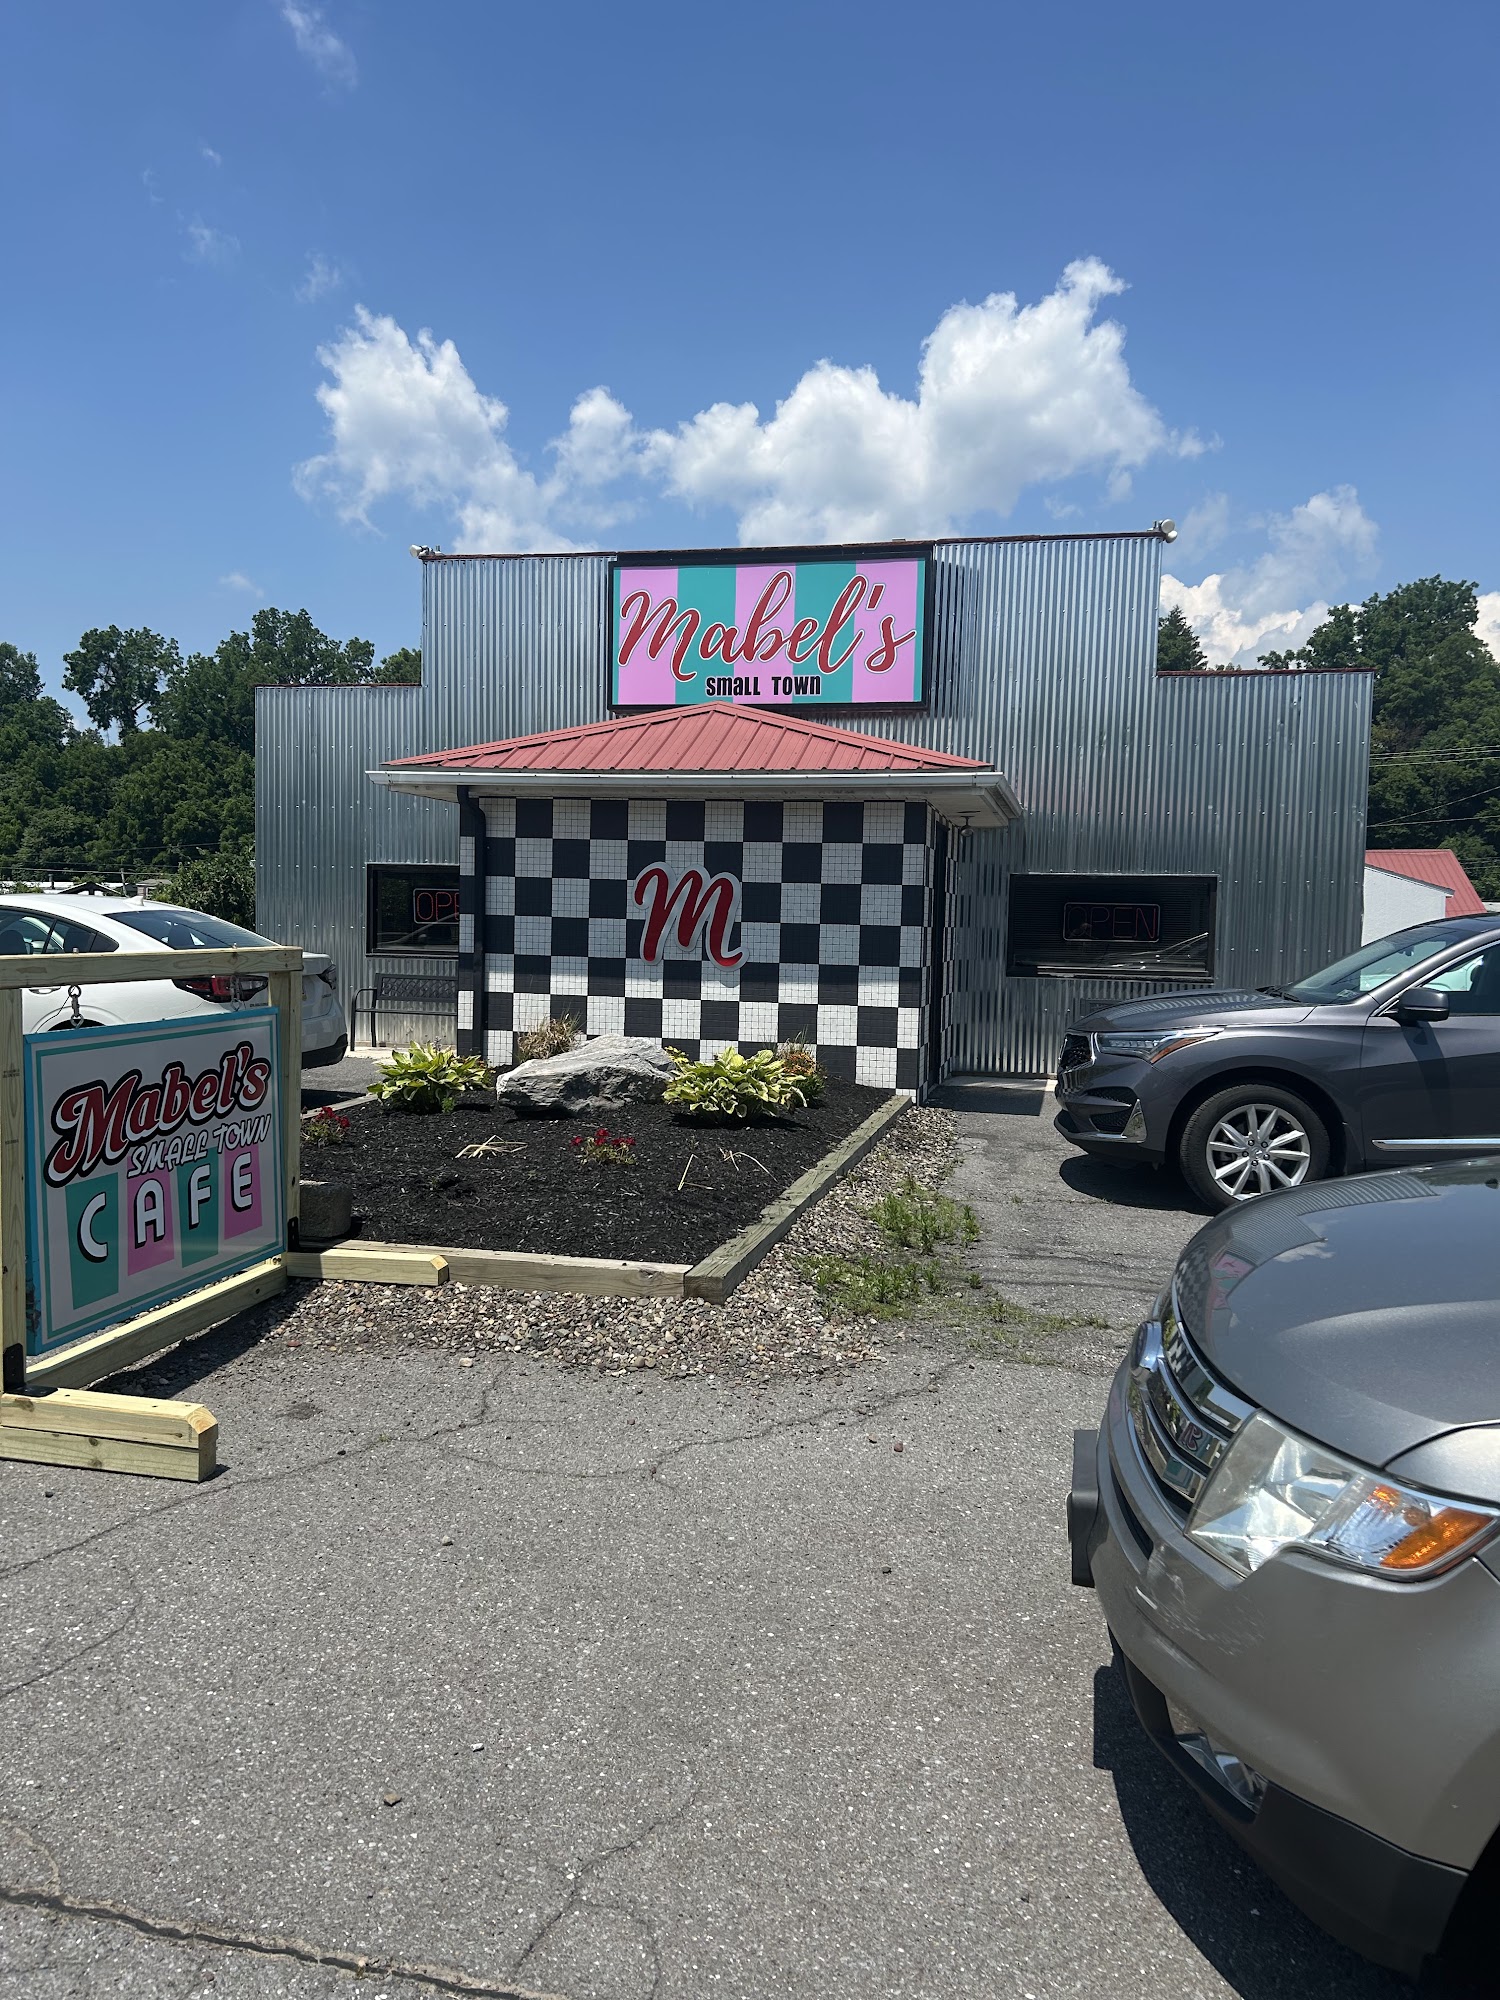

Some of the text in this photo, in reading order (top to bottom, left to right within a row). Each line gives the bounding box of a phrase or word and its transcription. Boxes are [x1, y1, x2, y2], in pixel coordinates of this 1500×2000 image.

[617, 571, 917, 682] Mabel's
[1068, 906, 1157, 939] OPEN
[46, 1043, 270, 1185] Mabel's
[128, 1114, 271, 1178] SMALL TOWN
[77, 1152, 253, 1262] CAFE
